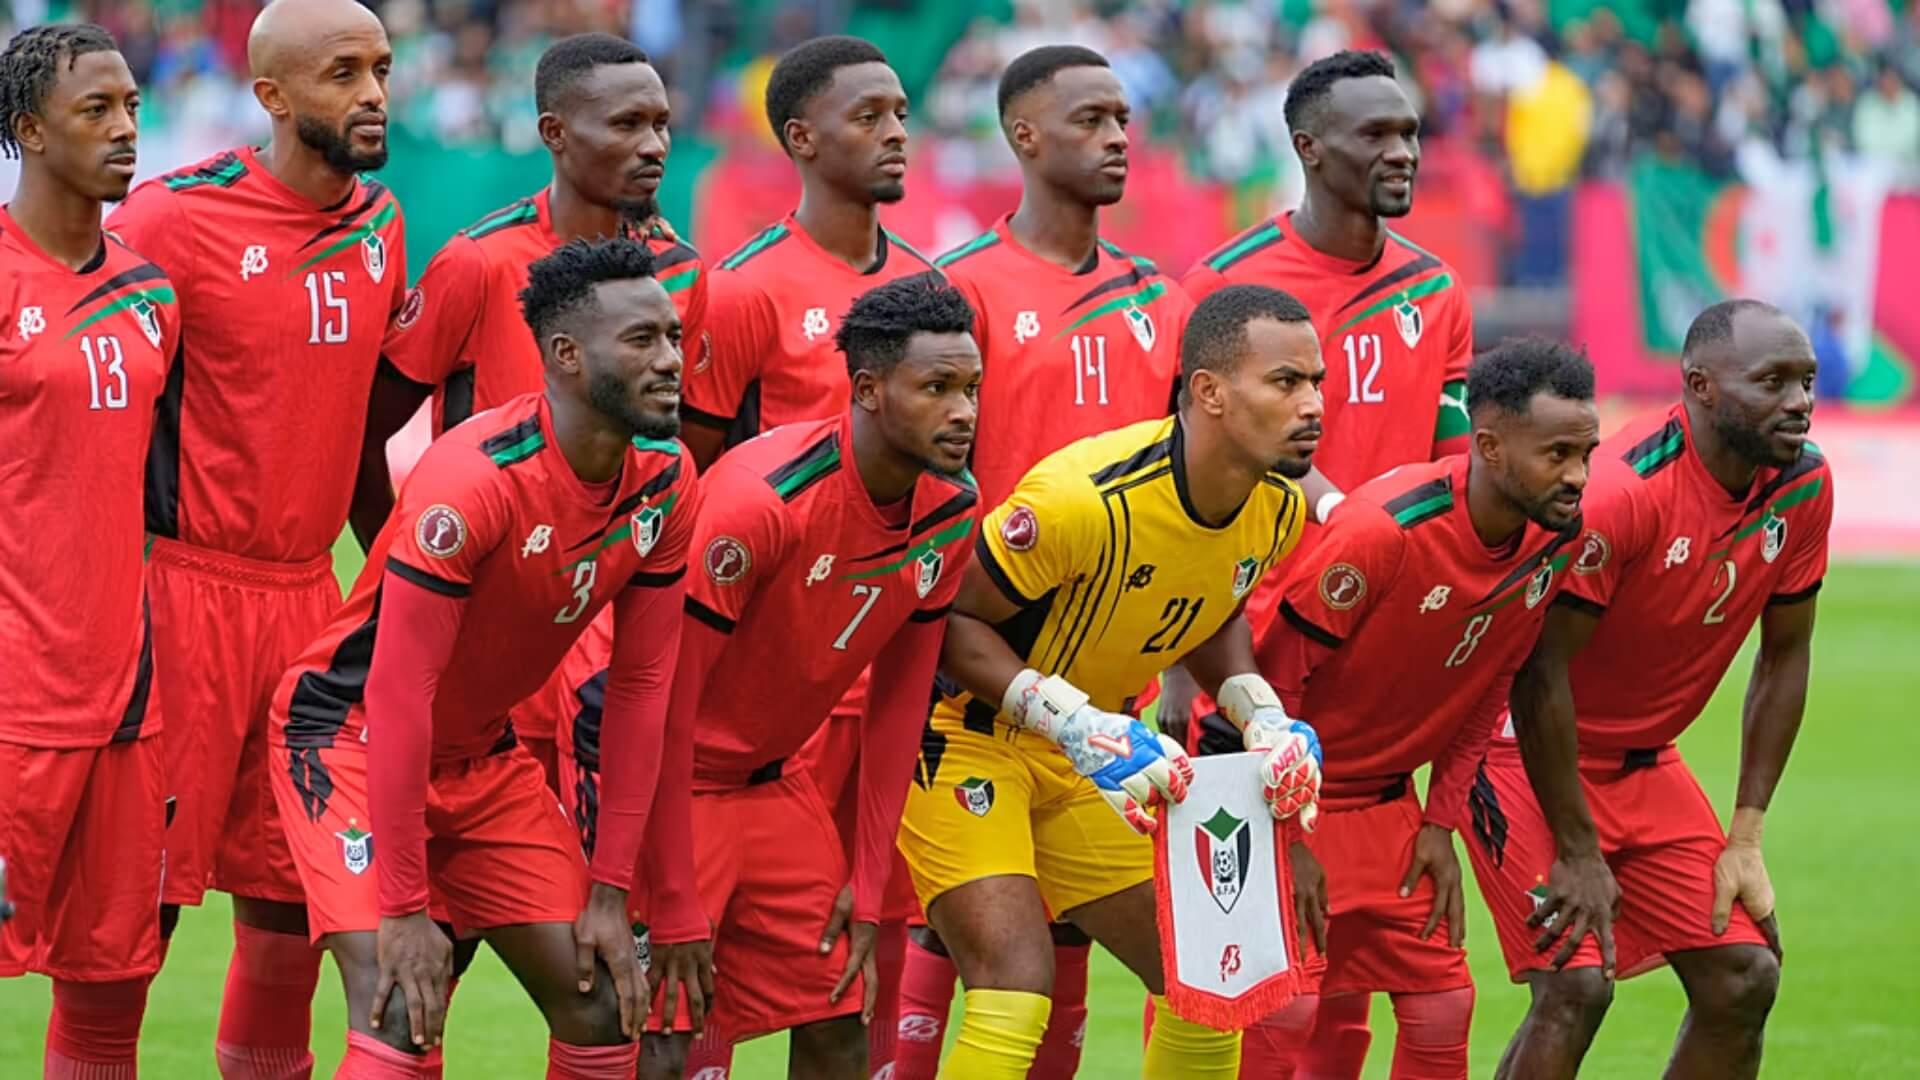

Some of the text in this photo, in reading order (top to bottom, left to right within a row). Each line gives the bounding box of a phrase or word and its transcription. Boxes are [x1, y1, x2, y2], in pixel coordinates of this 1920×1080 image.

[304, 271, 348, 344] 15
[80, 336, 129, 409] 13
[1069, 335, 1109, 405] 14
[1342, 334, 1386, 404] 12
[553, 559, 597, 624] 3
[832, 584, 882, 650] 7
[1702, 560, 1737, 625] 2
[1140, 596, 1206, 655] 21
[1444, 614, 1493, 668] 8
